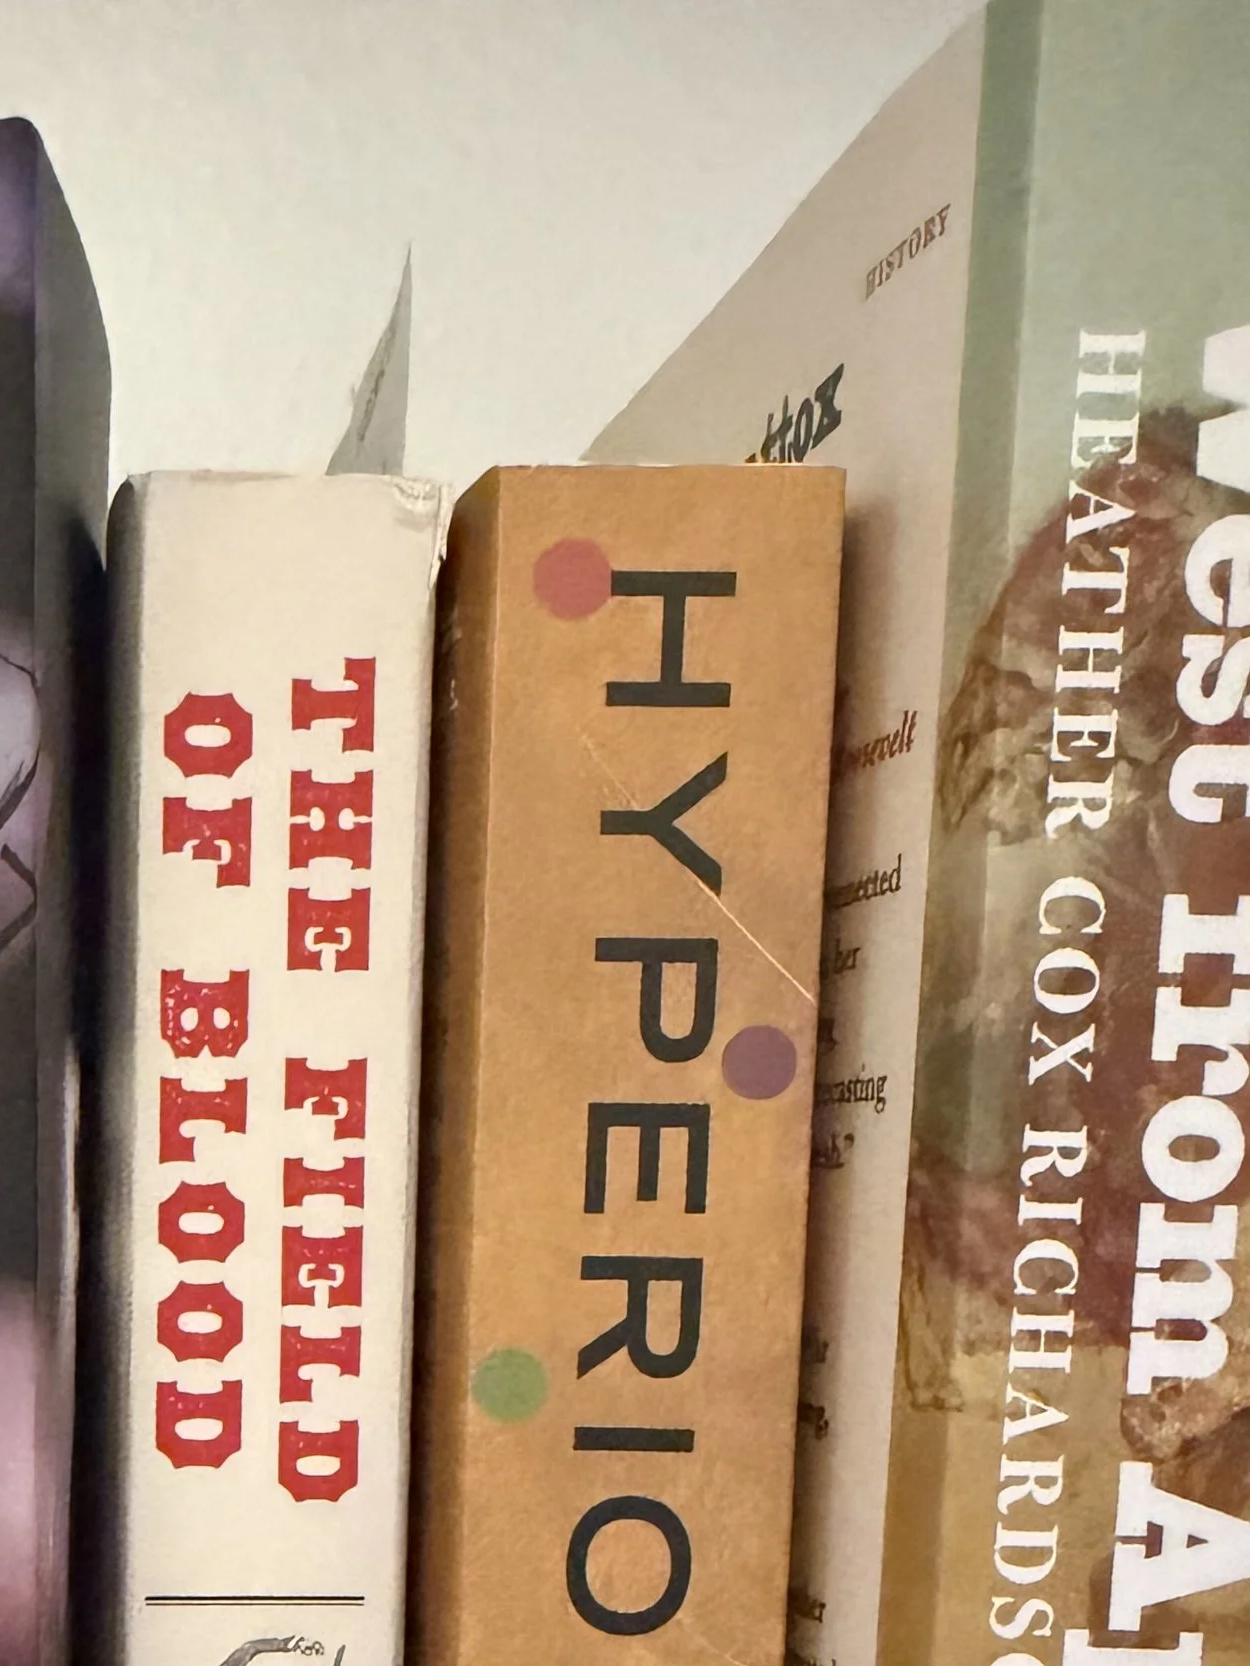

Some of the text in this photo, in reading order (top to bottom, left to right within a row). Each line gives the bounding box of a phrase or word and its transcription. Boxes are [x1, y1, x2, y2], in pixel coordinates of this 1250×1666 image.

[864, 203, 951, 300] HISTORY
[1046, 329, 1146, 839] HEATHER
[156, 693, 253, 1469] OF BLOOD
[278, 657, 376, 1502] THE FIELD
[1028, 876, 1106, 1084] COX
